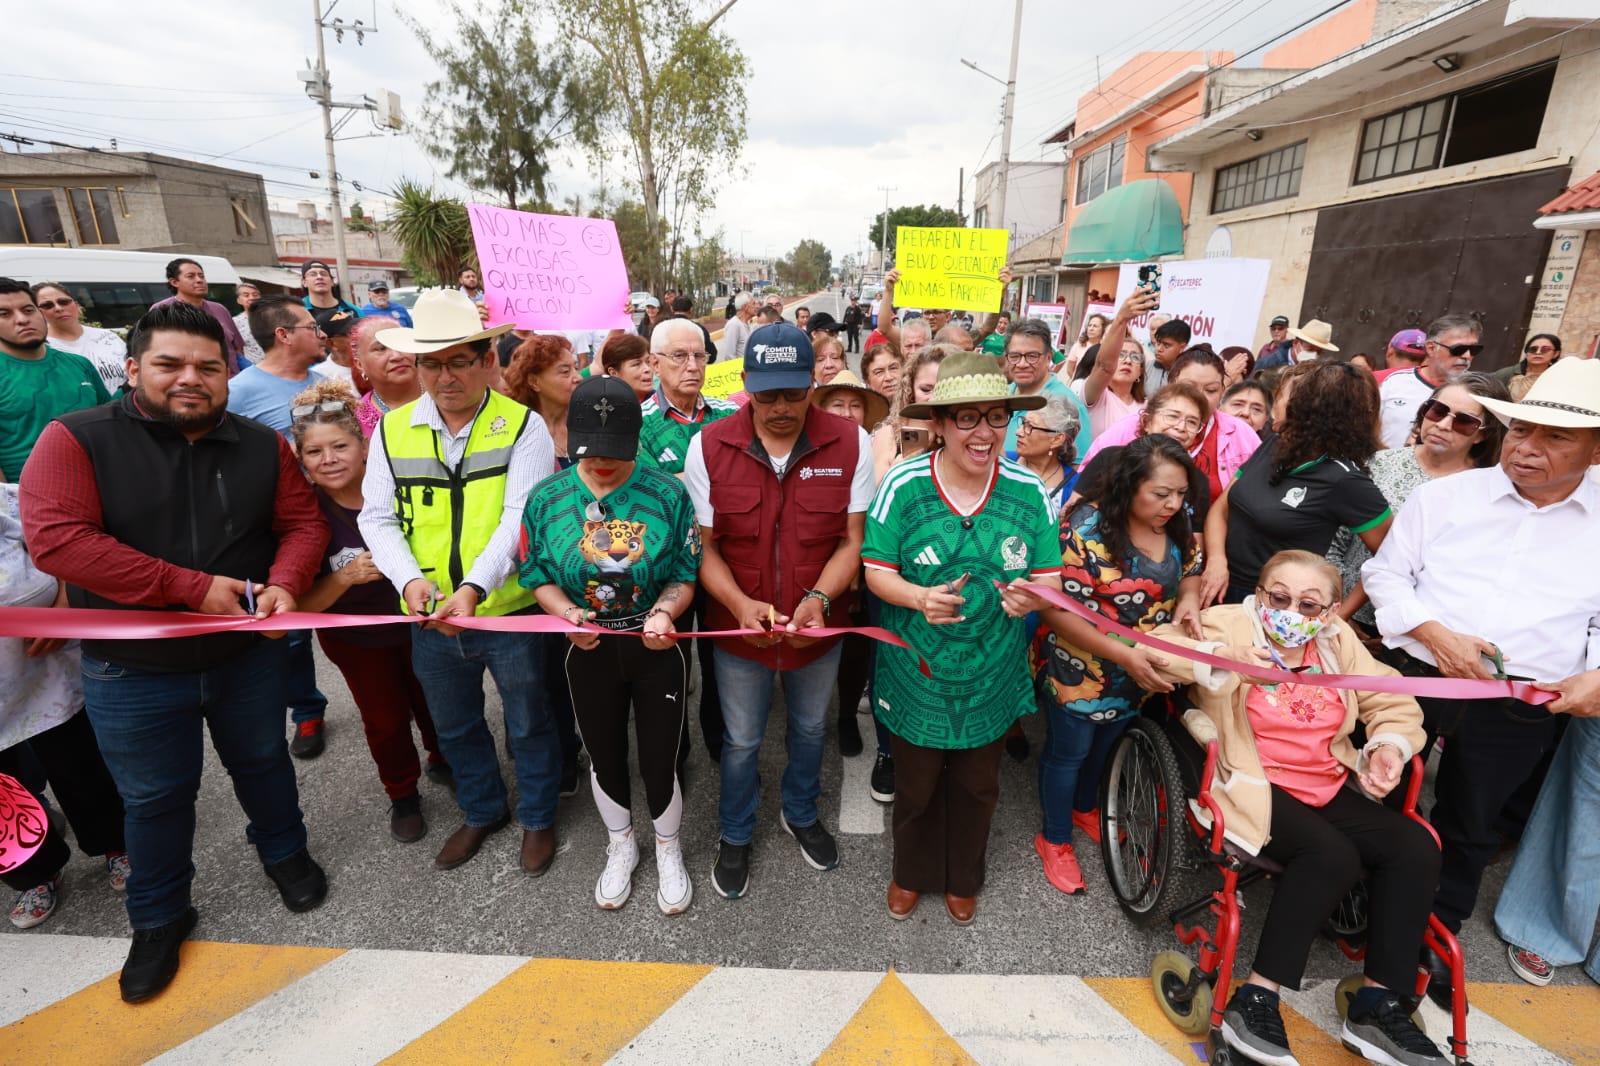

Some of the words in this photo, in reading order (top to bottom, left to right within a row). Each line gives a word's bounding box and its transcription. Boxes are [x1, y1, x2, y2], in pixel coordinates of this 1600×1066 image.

[475, 208, 510, 237] NO
[902, 230, 961, 250] REPAREN
[969, 232, 988, 251] EL
[491, 243, 578, 272] EXCUSAS
[906, 253, 938, 270] BLVD
[488, 269, 592, 295] QUEREMOS
[900, 280, 915, 297] NO
[602, 621, 629, 629] PUMA
